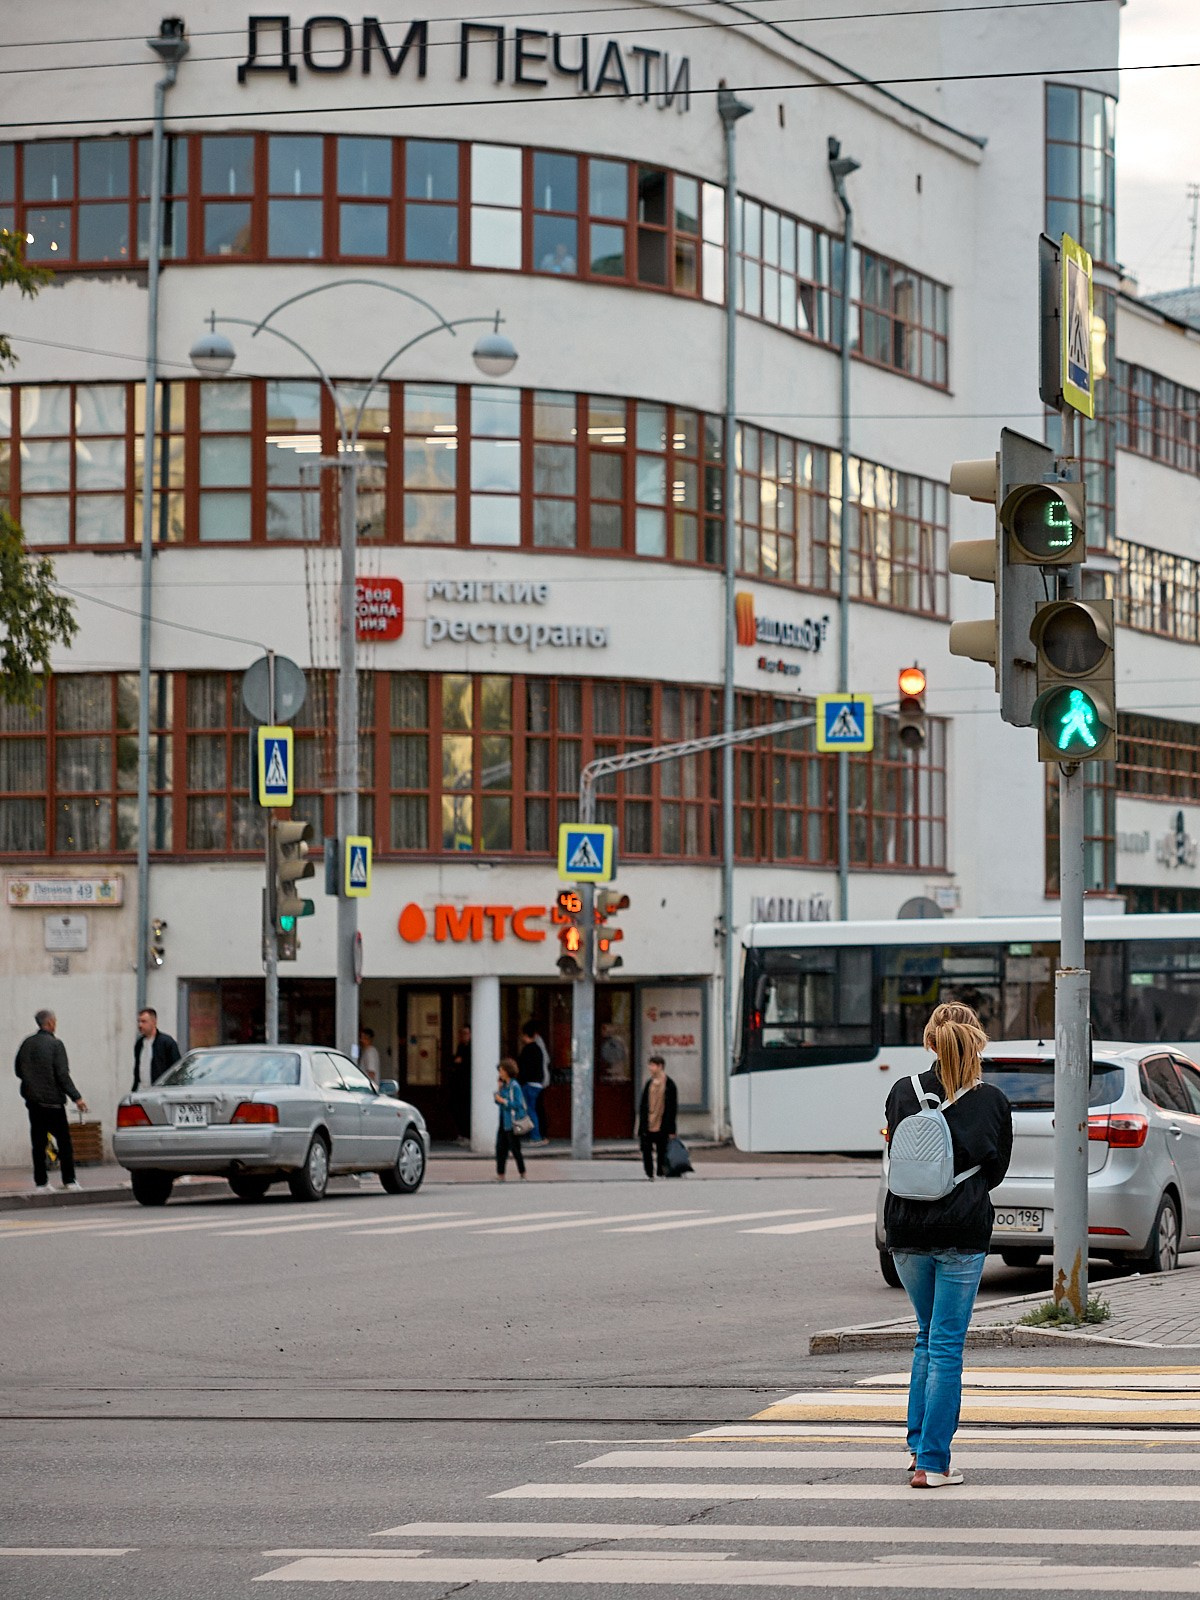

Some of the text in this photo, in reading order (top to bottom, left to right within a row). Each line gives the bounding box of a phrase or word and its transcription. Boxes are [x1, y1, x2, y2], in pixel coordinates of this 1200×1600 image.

[237, 15, 690, 115] ДОМ ПЕЧАТИ
[425, 616, 612, 652] рестораны
[434, 904, 547, 942] МТС
